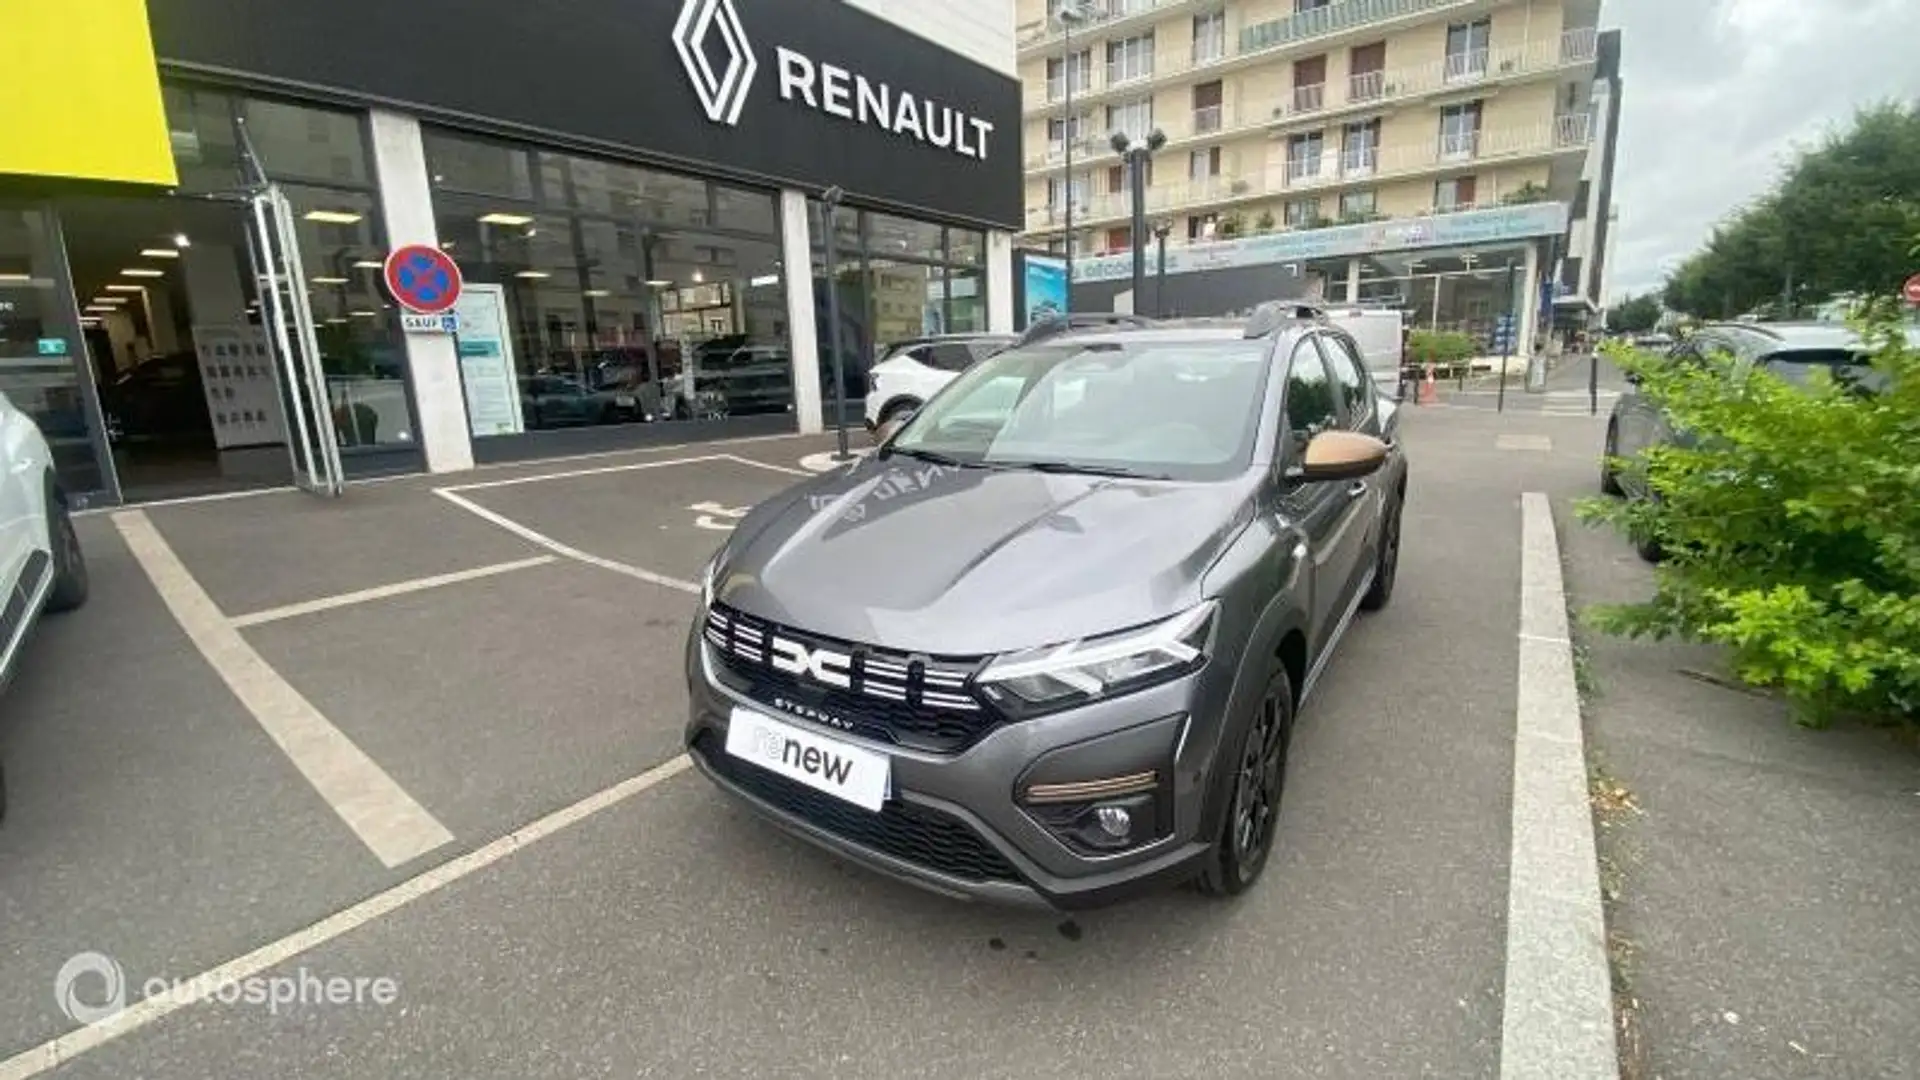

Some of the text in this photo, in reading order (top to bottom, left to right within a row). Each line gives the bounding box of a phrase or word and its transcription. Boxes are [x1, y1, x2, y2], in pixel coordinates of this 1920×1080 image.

[776, 46, 995, 160] RENAULT
[405, 316, 437, 328] SAUF
[774, 698, 854, 729] STEPWAY
